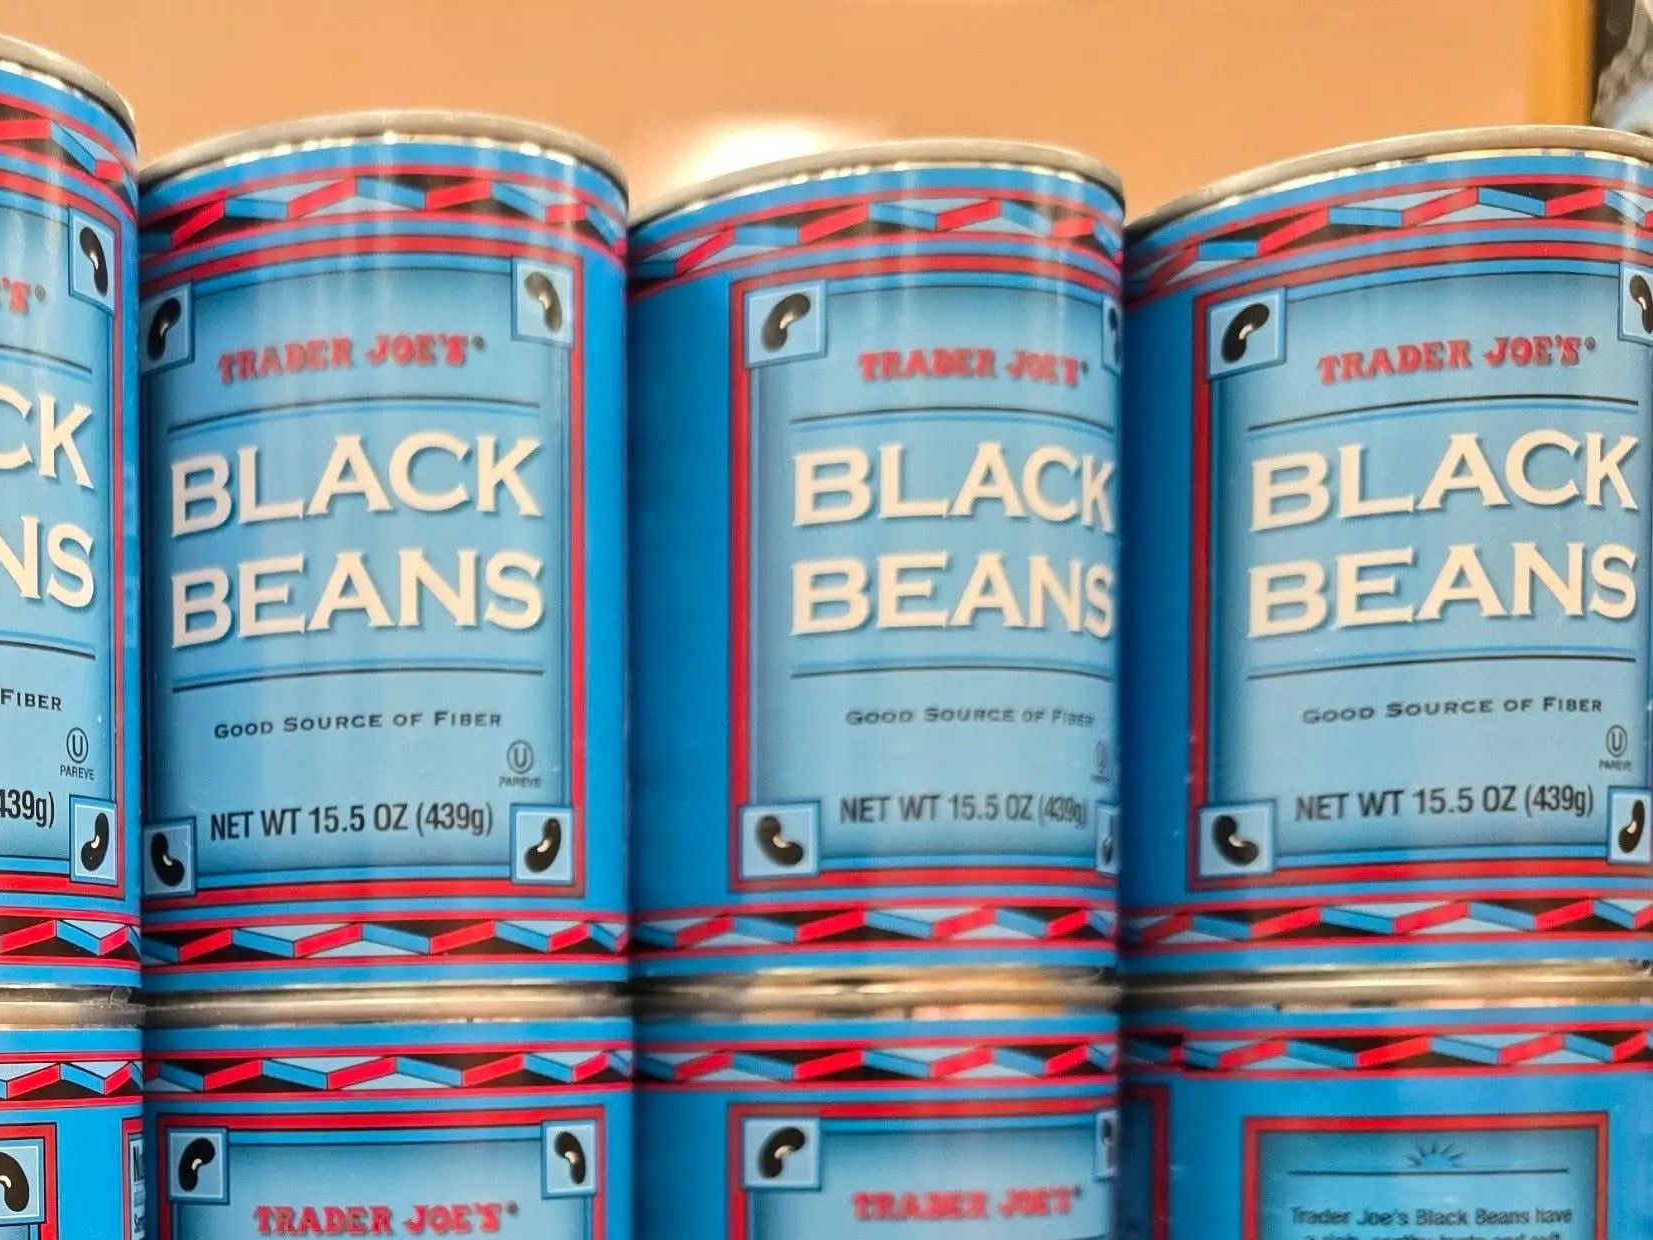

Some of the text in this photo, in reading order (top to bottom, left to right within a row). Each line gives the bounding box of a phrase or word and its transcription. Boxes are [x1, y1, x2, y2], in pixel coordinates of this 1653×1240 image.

[170, 431, 543, 539] BLACK
[792, 441, 1114, 534] BLACK
[1249, 429, 1640, 533] BLACK
[171, 547, 544, 648] BEANS
[790, 550, 1114, 639] BEANS
[1248, 542, 1638, 639] BEANS
[0, 688, 63, 711] FIBER
[1290, 1206, 1573, 1226] Trader Joe's Black Beans have
